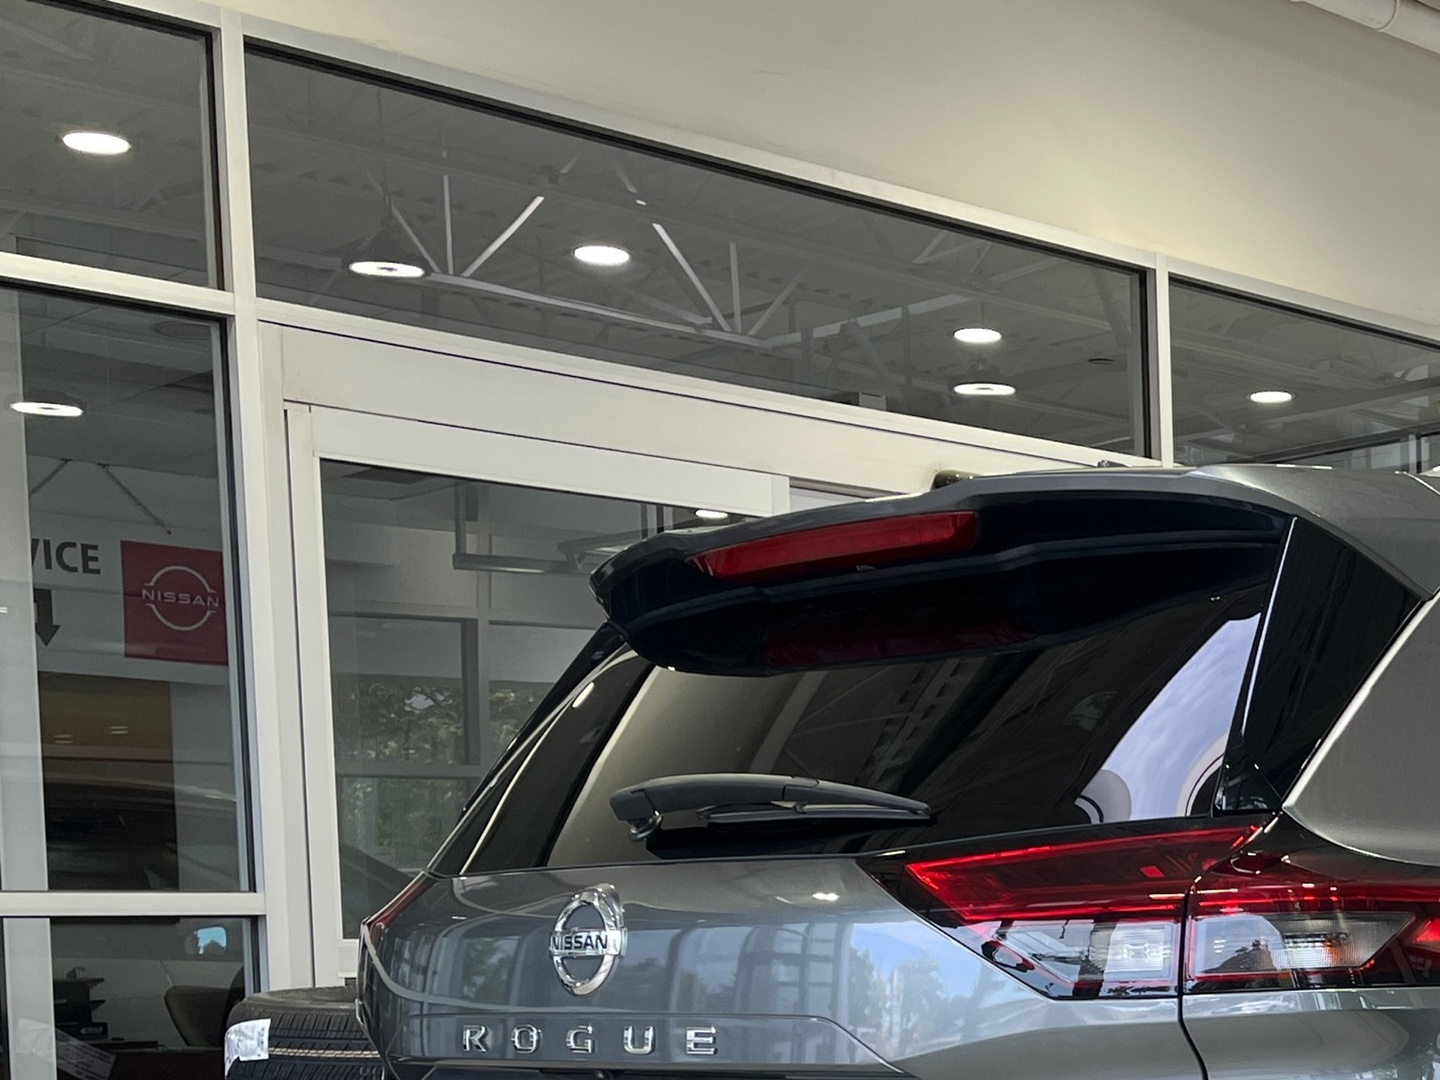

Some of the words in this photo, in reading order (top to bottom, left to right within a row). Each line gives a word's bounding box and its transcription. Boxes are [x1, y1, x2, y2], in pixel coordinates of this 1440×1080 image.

[141, 588, 219, 607] NISSAN
[551, 934, 608, 951] NISSAN
[462, 1024, 719, 1055] ROGUE
